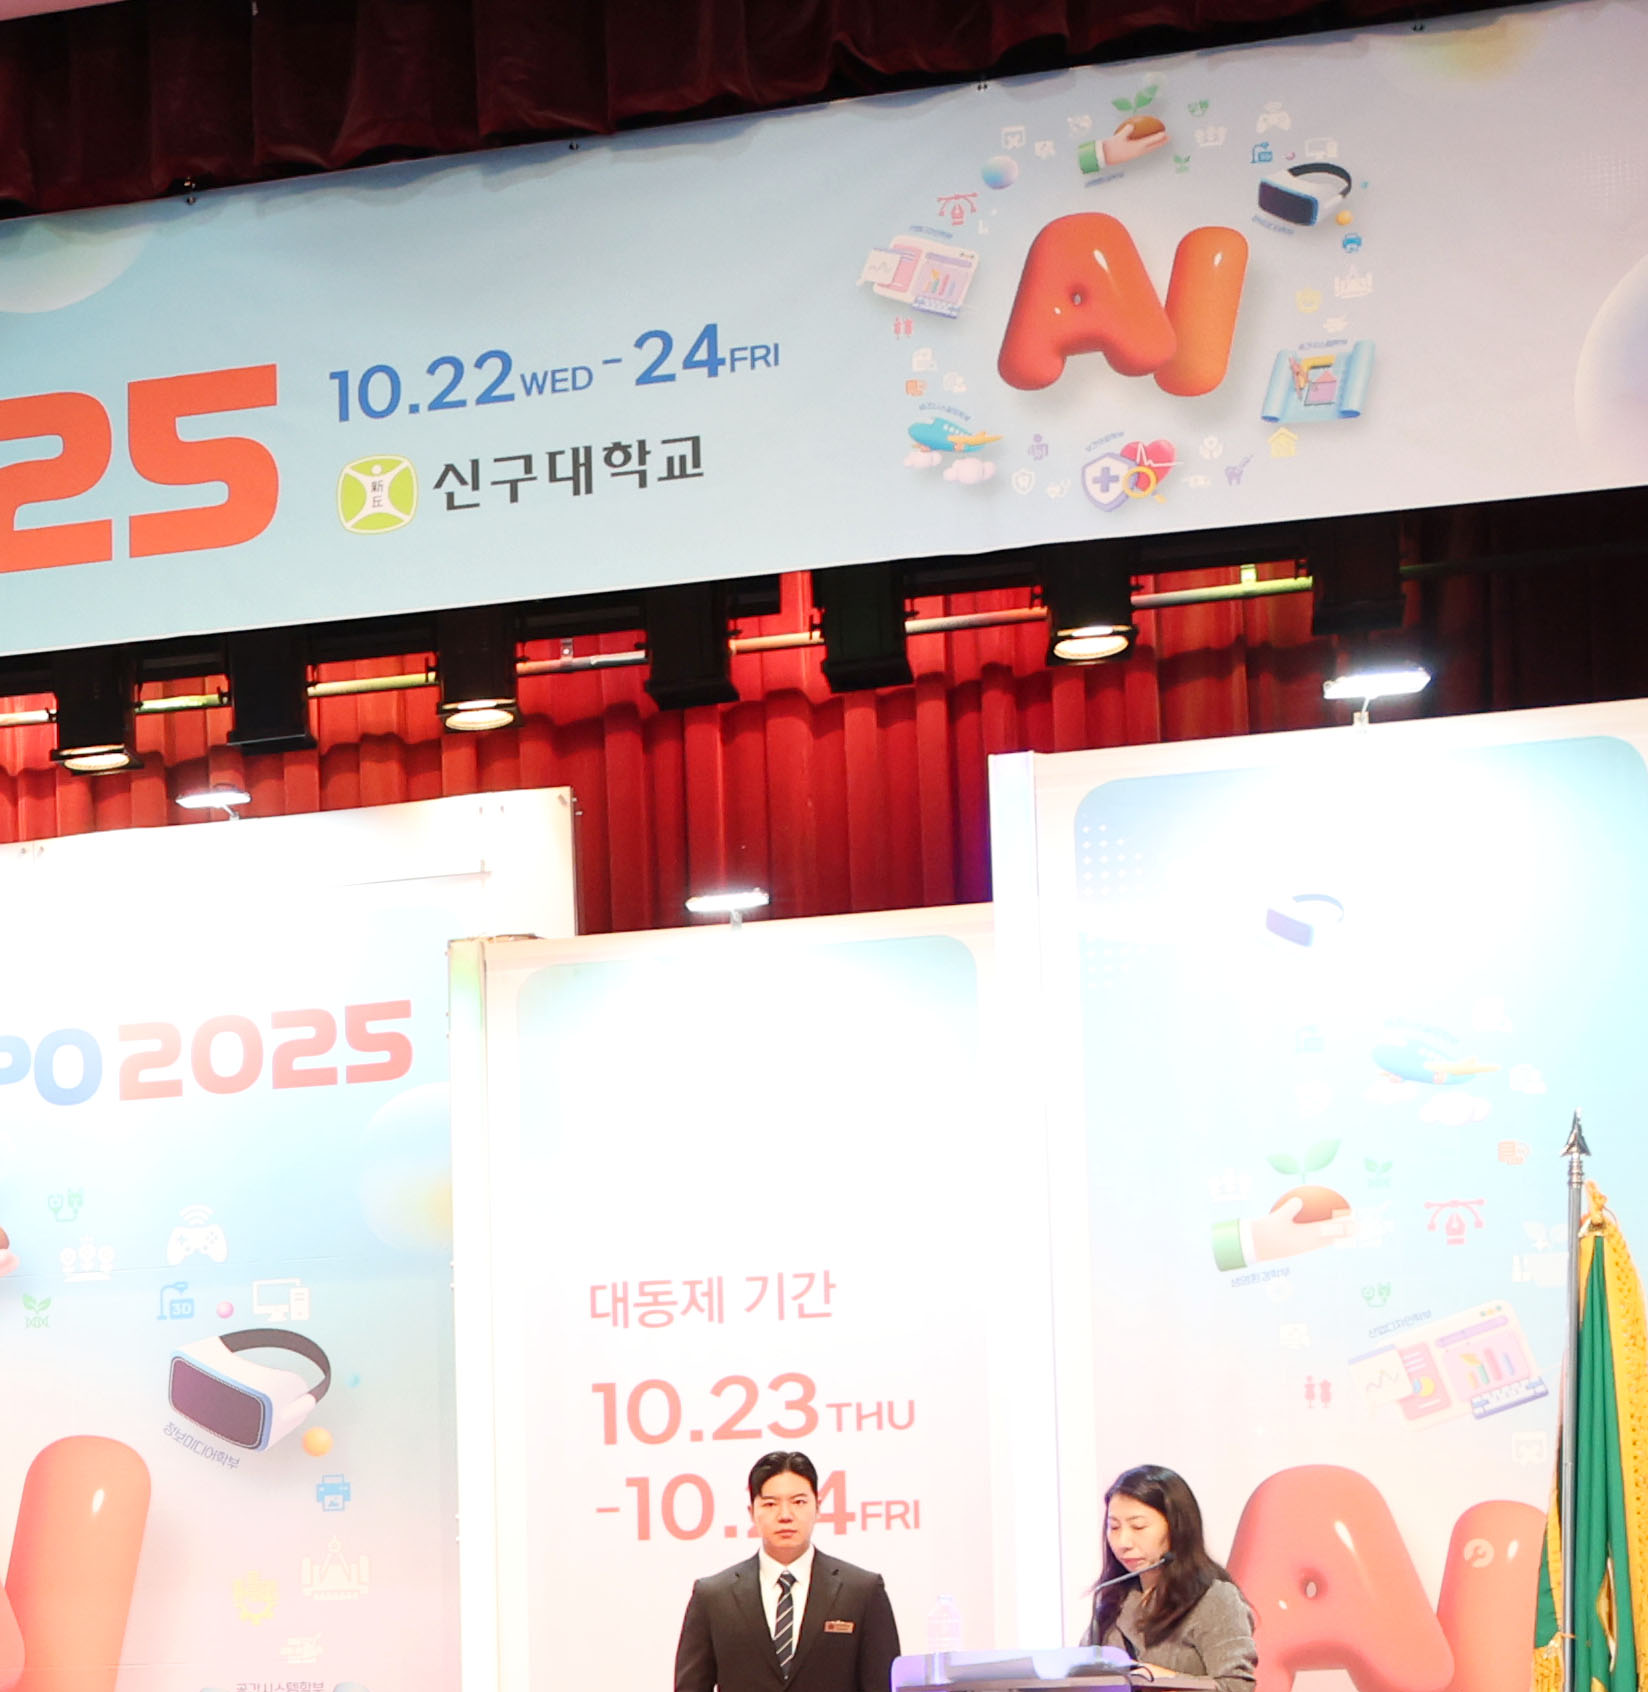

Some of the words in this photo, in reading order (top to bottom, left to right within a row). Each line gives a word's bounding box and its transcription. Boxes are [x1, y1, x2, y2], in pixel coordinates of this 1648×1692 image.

[998, 210, 1249, 396] AI
[431, 434, 704, 512] 신구대학교
[117, 998, 414, 1102] 2025
[588, 1275, 726, 1330] 대동제
[743, 1269, 838, 1322] 기간
[162, 1420, 242, 1471] 정보미디어학부
